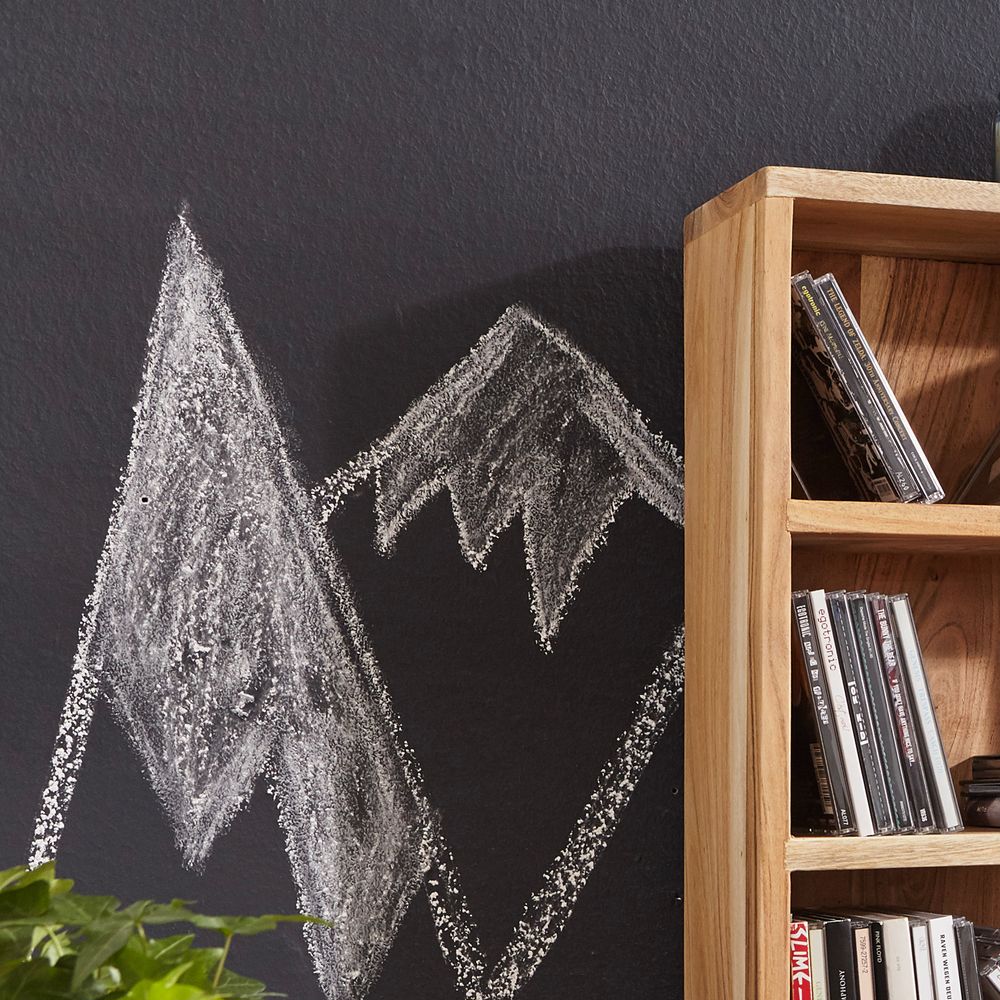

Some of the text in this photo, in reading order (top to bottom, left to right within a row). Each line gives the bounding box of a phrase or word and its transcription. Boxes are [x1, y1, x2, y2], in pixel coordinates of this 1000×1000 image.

[801, 285, 821, 317] egotronic
[826, 287, 838, 301] THE
[833, 302, 850, 328] LEGEND
[847, 328, 858, 338] OF
[852, 338, 866, 361] ZELDA:
[818, 608, 837, 671] egotronic
[939, 934, 947, 958] RAVEN
[942, 959, 950, 985] WEGEN
